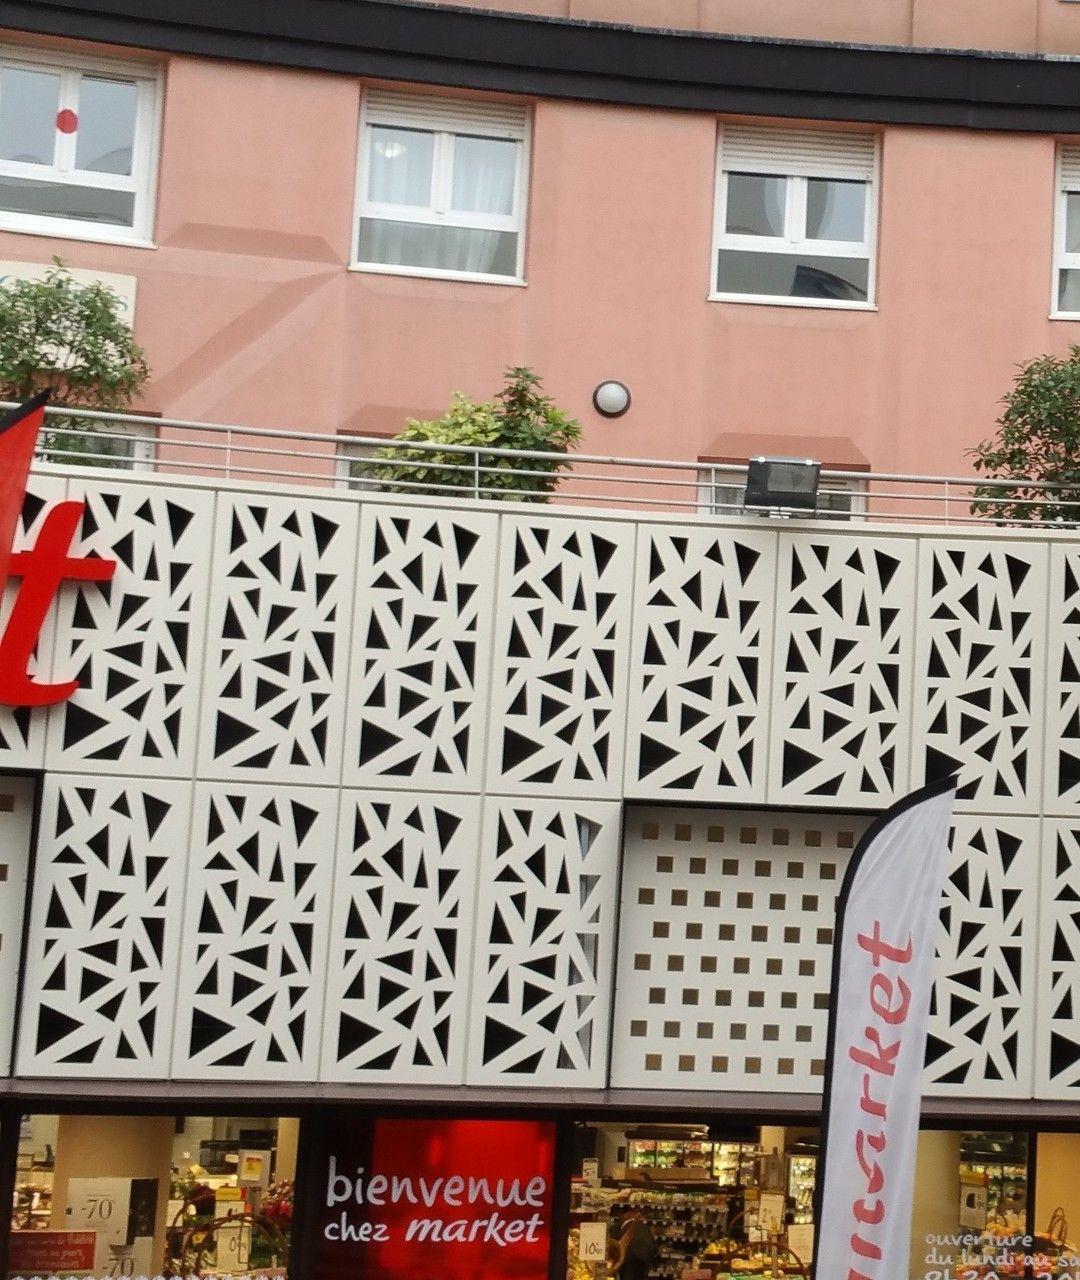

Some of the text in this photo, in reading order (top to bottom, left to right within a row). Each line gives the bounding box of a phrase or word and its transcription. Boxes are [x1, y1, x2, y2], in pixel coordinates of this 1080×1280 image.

[326, 1155, 547, 1208] bienvenue
[324, 1211, 544, 1247] chez market
[925, 1233, 1033, 1247] ouverture
[925, 1247, 952, 1265] du
[962, 1247, 1015, 1266] lundi
[1023, 1253, 1048, 1267] au
